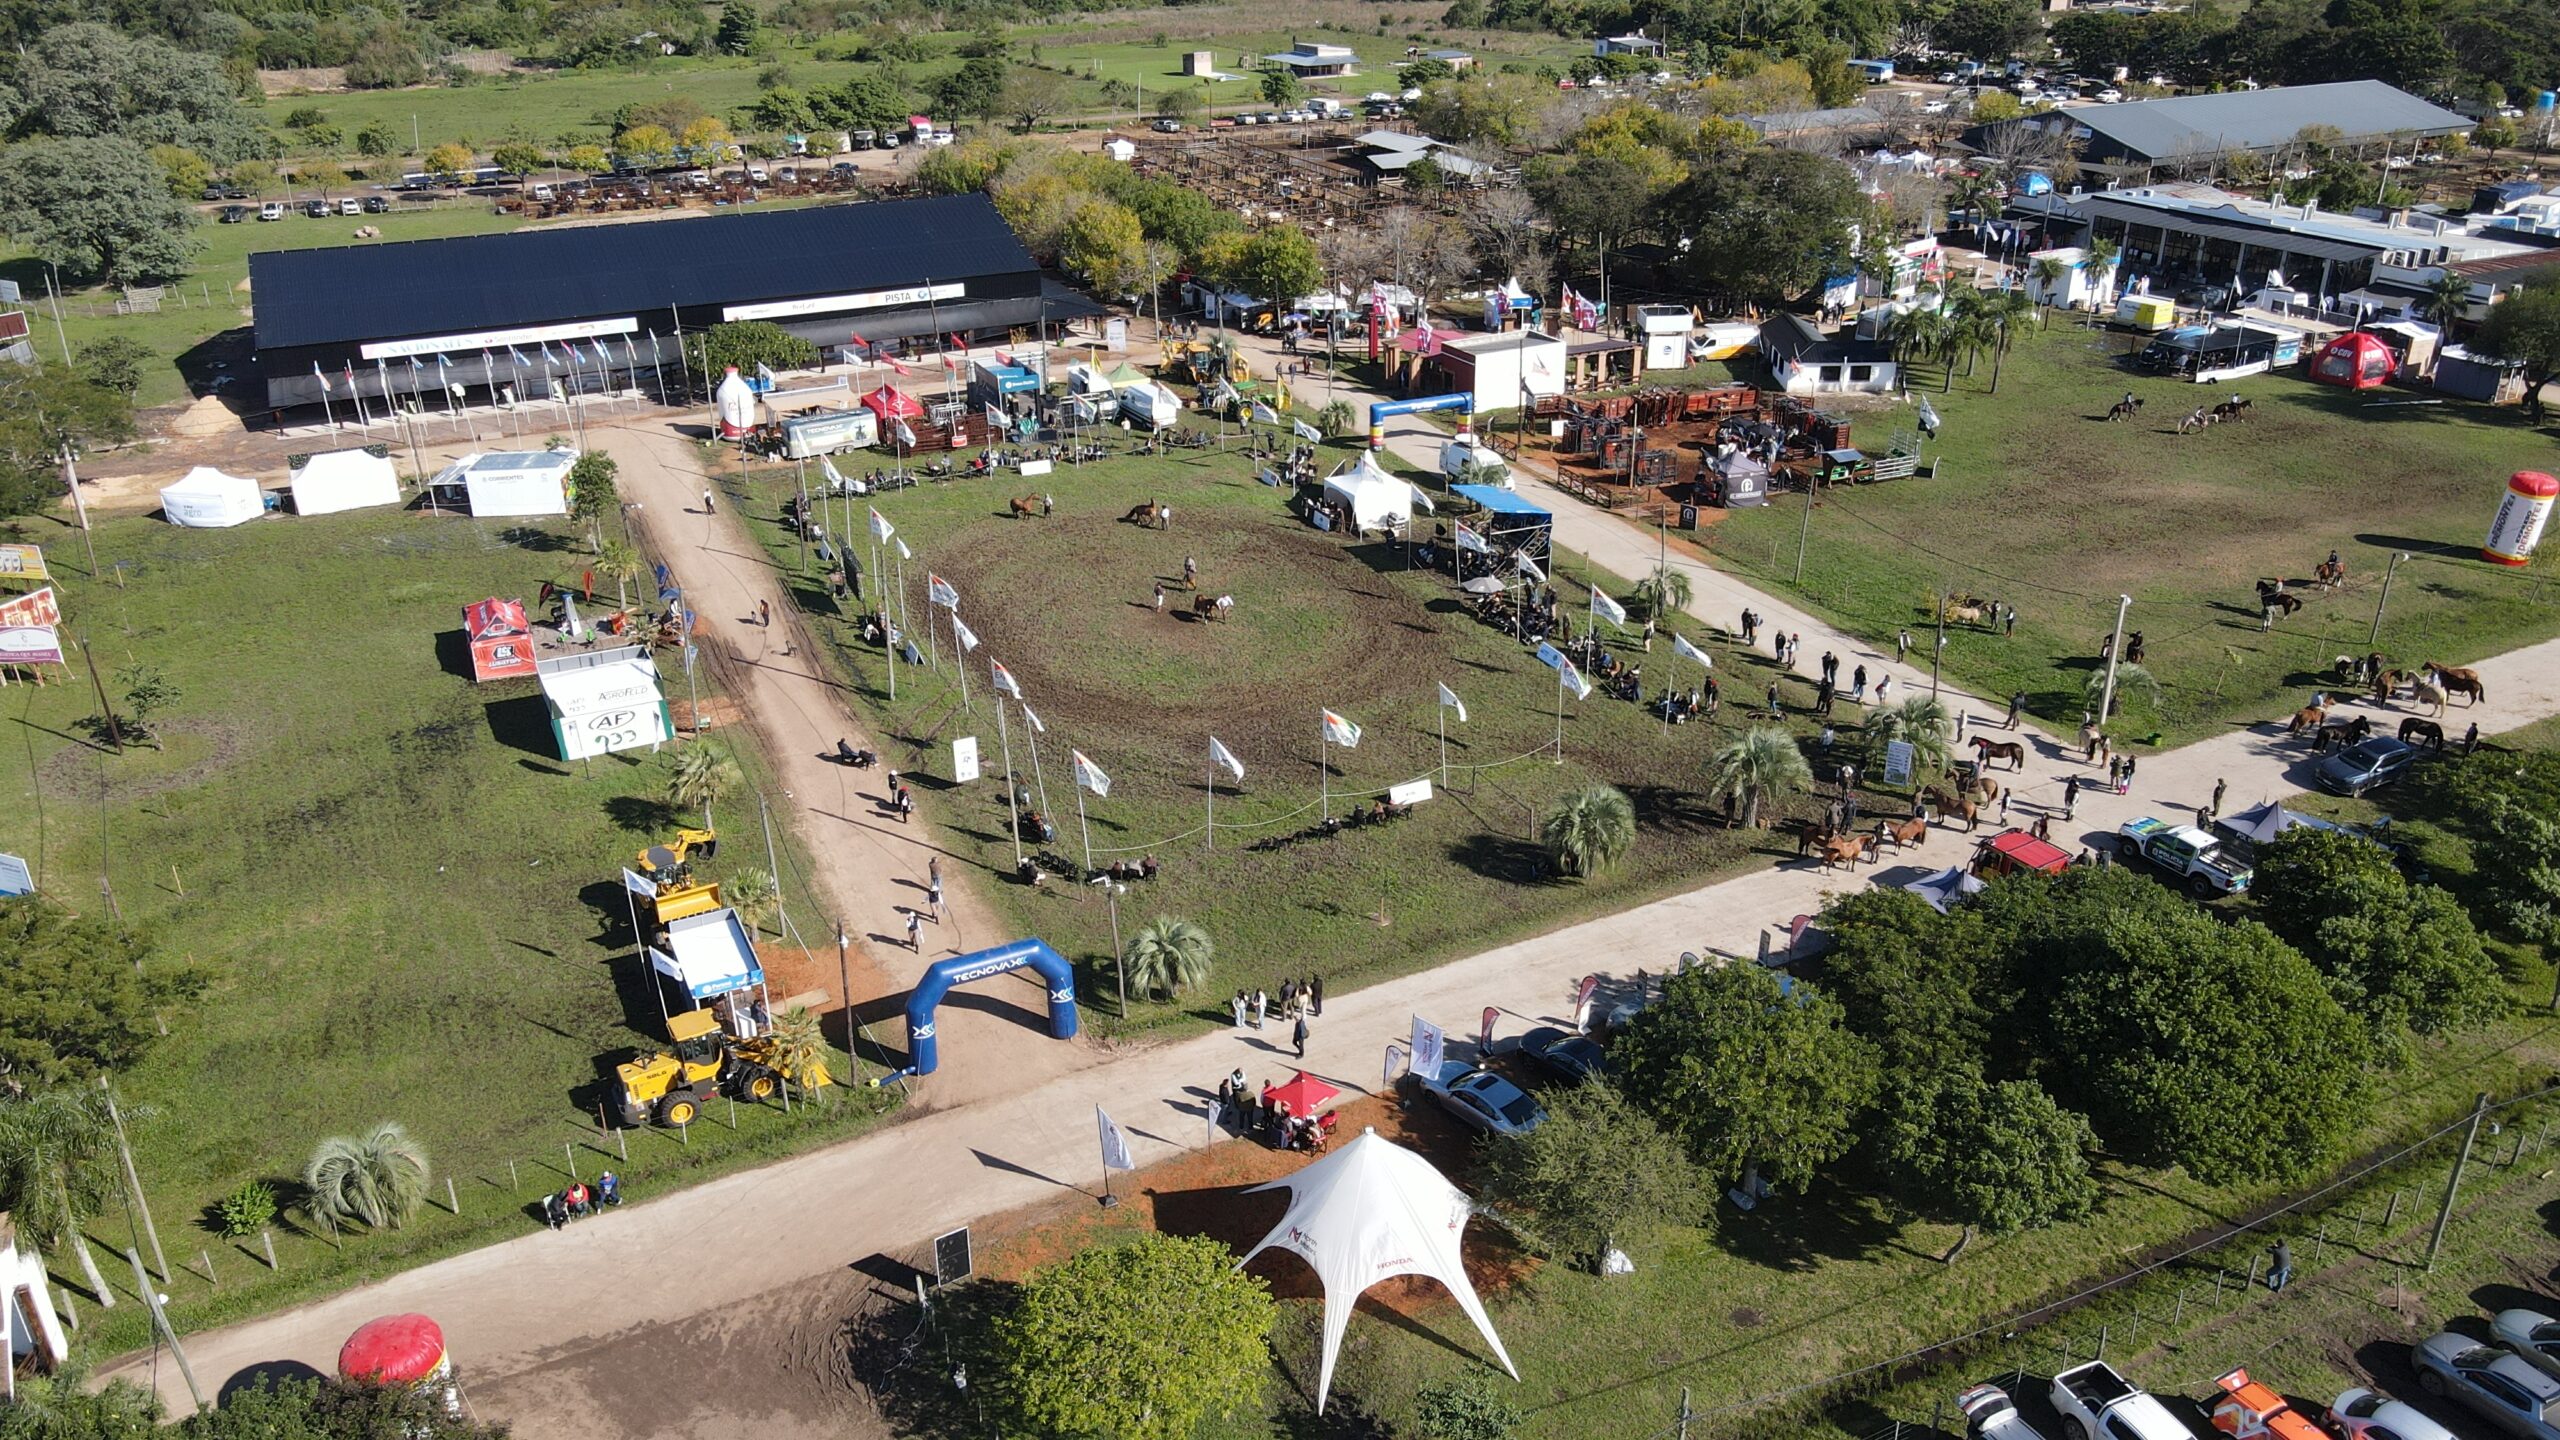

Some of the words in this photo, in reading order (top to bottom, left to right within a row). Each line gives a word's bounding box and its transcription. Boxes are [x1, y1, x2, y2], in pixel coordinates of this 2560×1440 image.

[885, 292, 911, 303] PISTA
[494, 333, 533, 343] Santander
[598, 712, 628, 728] AF
[2158, 850, 2184, 865] POLICIA
[953, 957, 1023, 983] TECNOVAX
[1303, 1232, 1317, 1247] North
[1377, 1257, 1413, 1270] HONDA
